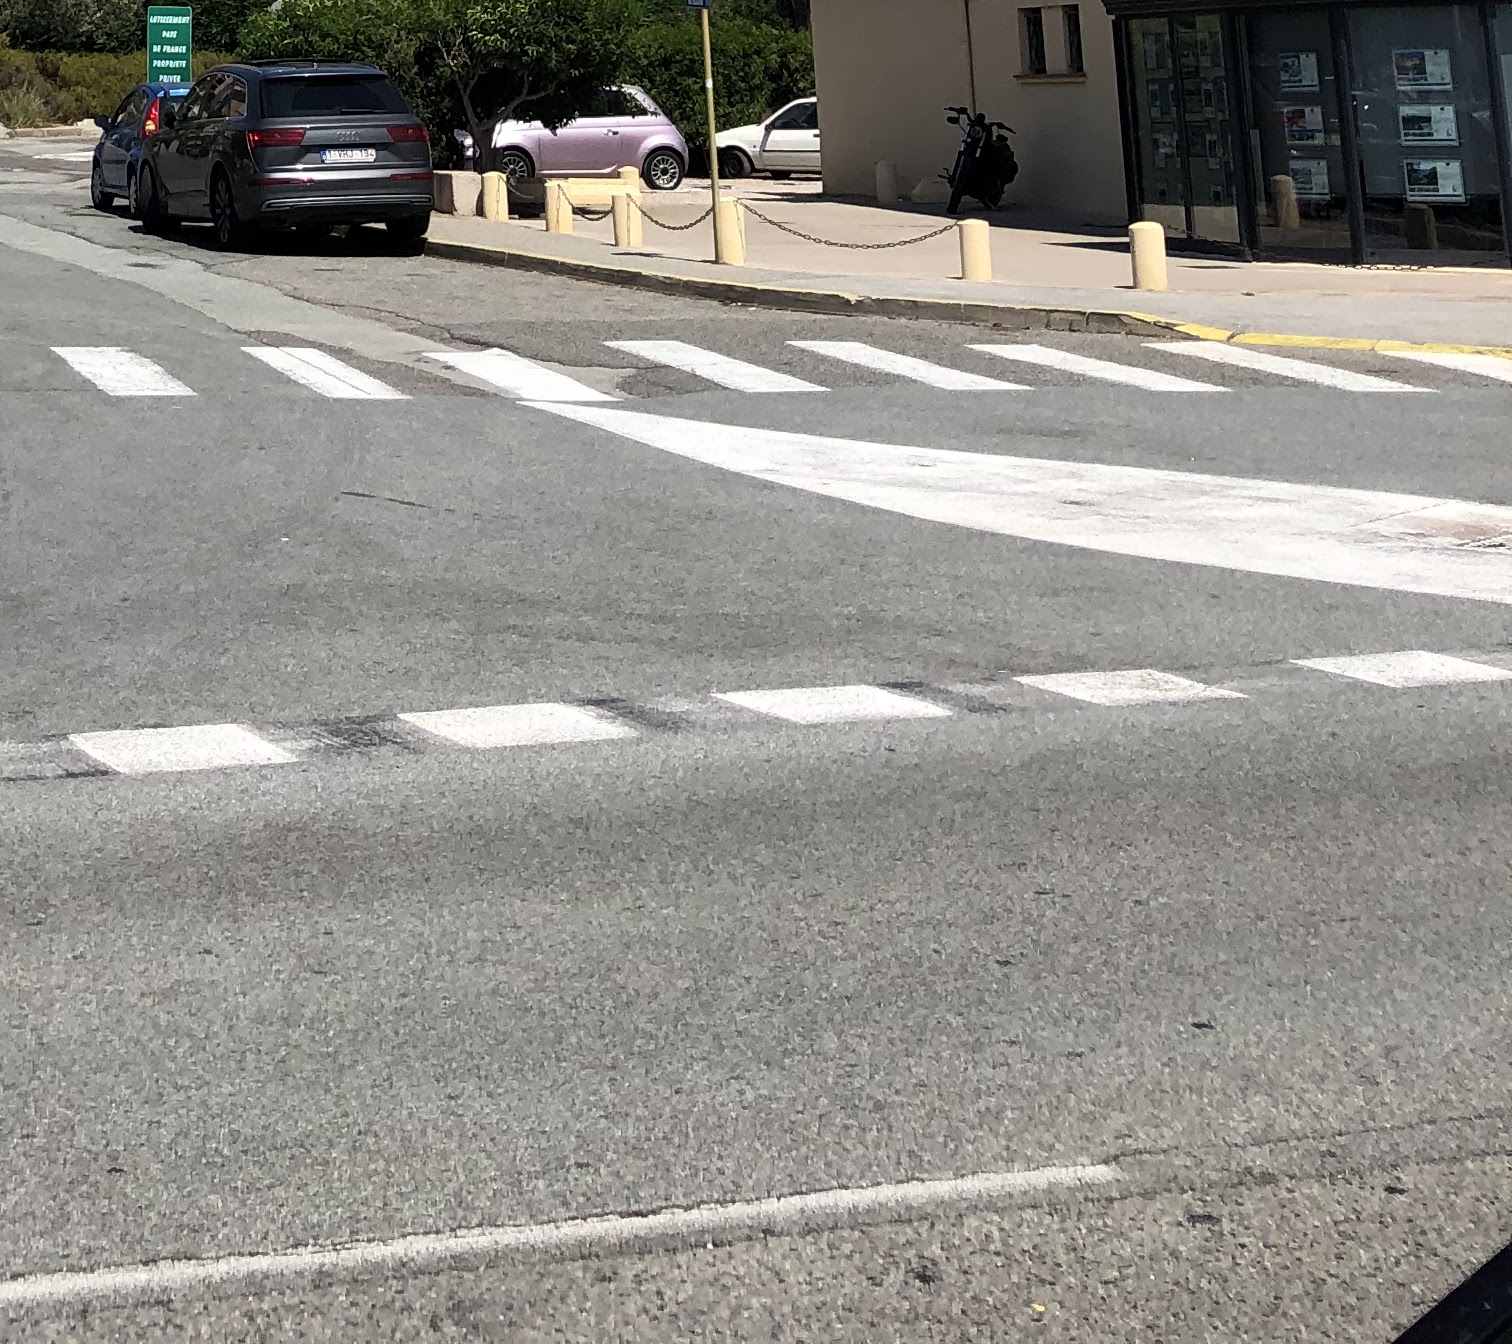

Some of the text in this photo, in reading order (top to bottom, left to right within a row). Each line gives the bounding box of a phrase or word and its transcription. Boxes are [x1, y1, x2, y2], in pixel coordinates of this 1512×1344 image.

[150, 16, 190, 24] LOTISSEMENT
[153, 45, 186, 53] DE FRANCE
